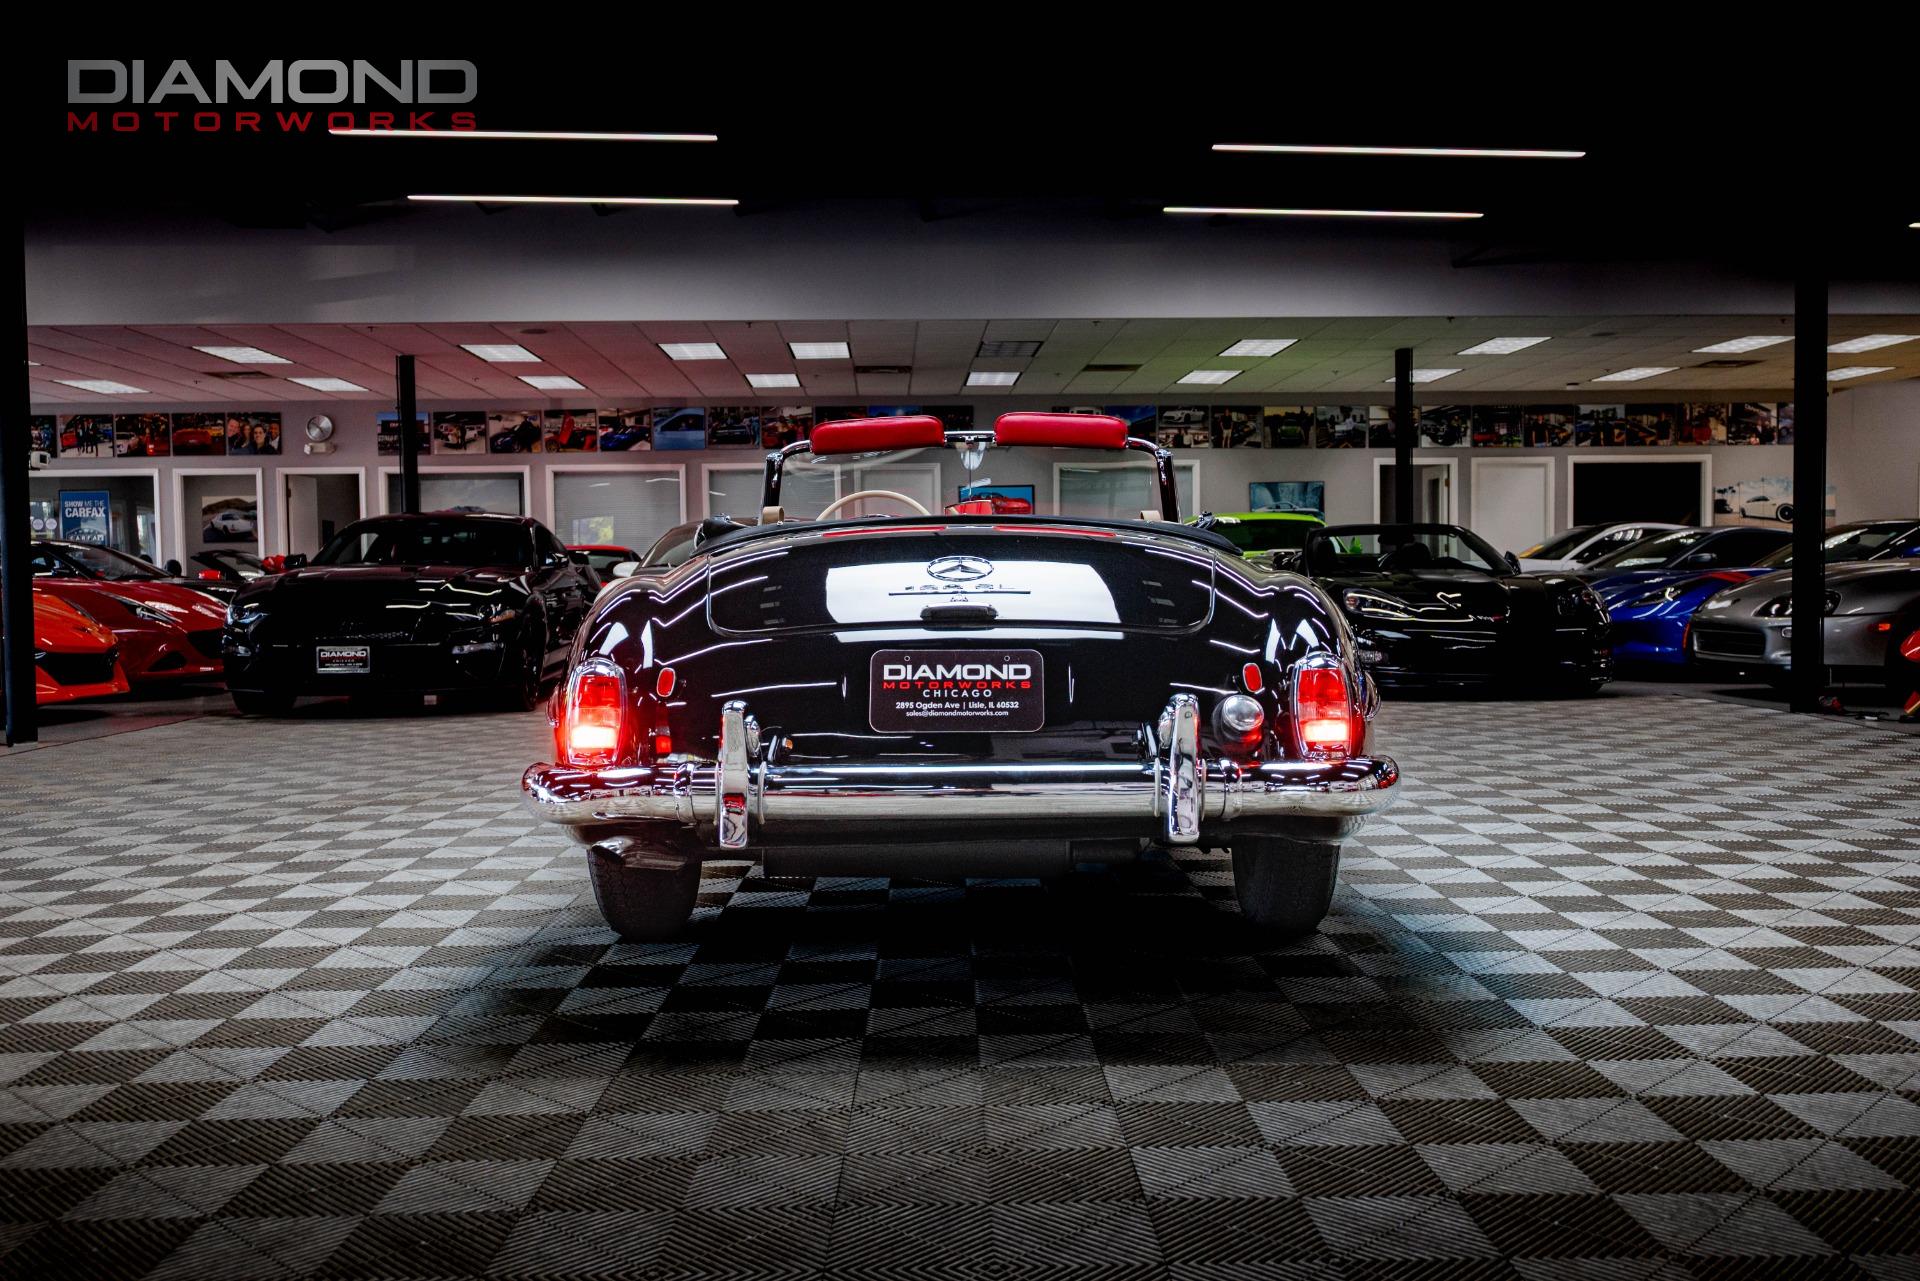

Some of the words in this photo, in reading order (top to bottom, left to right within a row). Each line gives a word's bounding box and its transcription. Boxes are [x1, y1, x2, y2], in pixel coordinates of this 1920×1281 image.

[65, 508, 105, 518] CARFAX
[883, 664, 1032, 680] DIAMOND
[883, 681, 1032, 689] MOTORWORKS
[922, 689, 993, 698] CHICAGO
[895, 701, 914, 709] 2895
[915, 701, 942, 711] Ogden
[944, 701, 960, 709] Ave
[968, 701, 987, 710] Lisle,
[988, 701, 995, 709] IL
[996, 701, 1020, 709] 60532
[905, 709, 1009, 717] sales@diamondmotorworks.com
